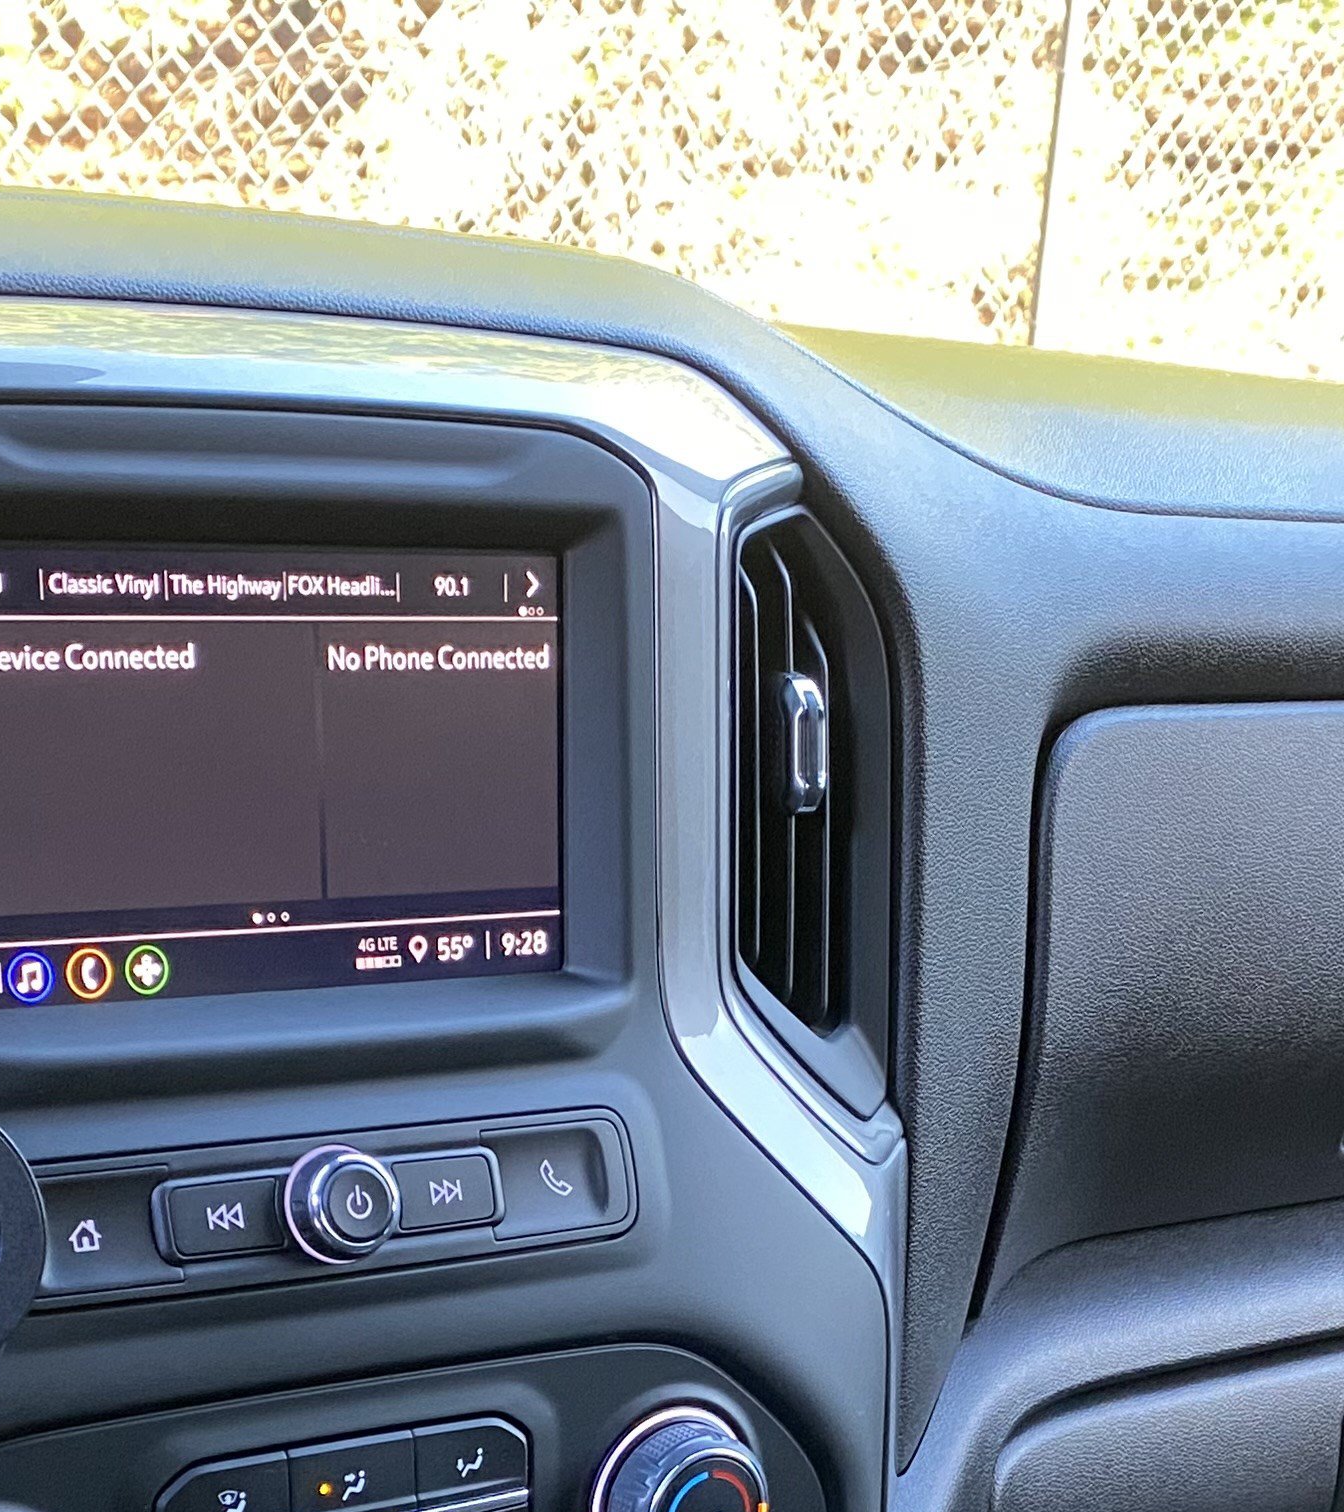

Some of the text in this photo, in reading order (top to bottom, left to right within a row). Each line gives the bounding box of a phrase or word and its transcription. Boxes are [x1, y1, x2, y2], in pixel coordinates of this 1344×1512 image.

[48, 573, 159, 600] Classic Vinyl
[169, 574, 282, 600] The Highway
[288, 575, 324, 596] FOX
[434, 577, 469, 597] 90.1
[64, 642, 195, 671] Connected
[327, 643, 550, 671] No Phone Connected
[358, 937, 398, 952] 4G LTE
[501, 929, 547, 956] 9:28
